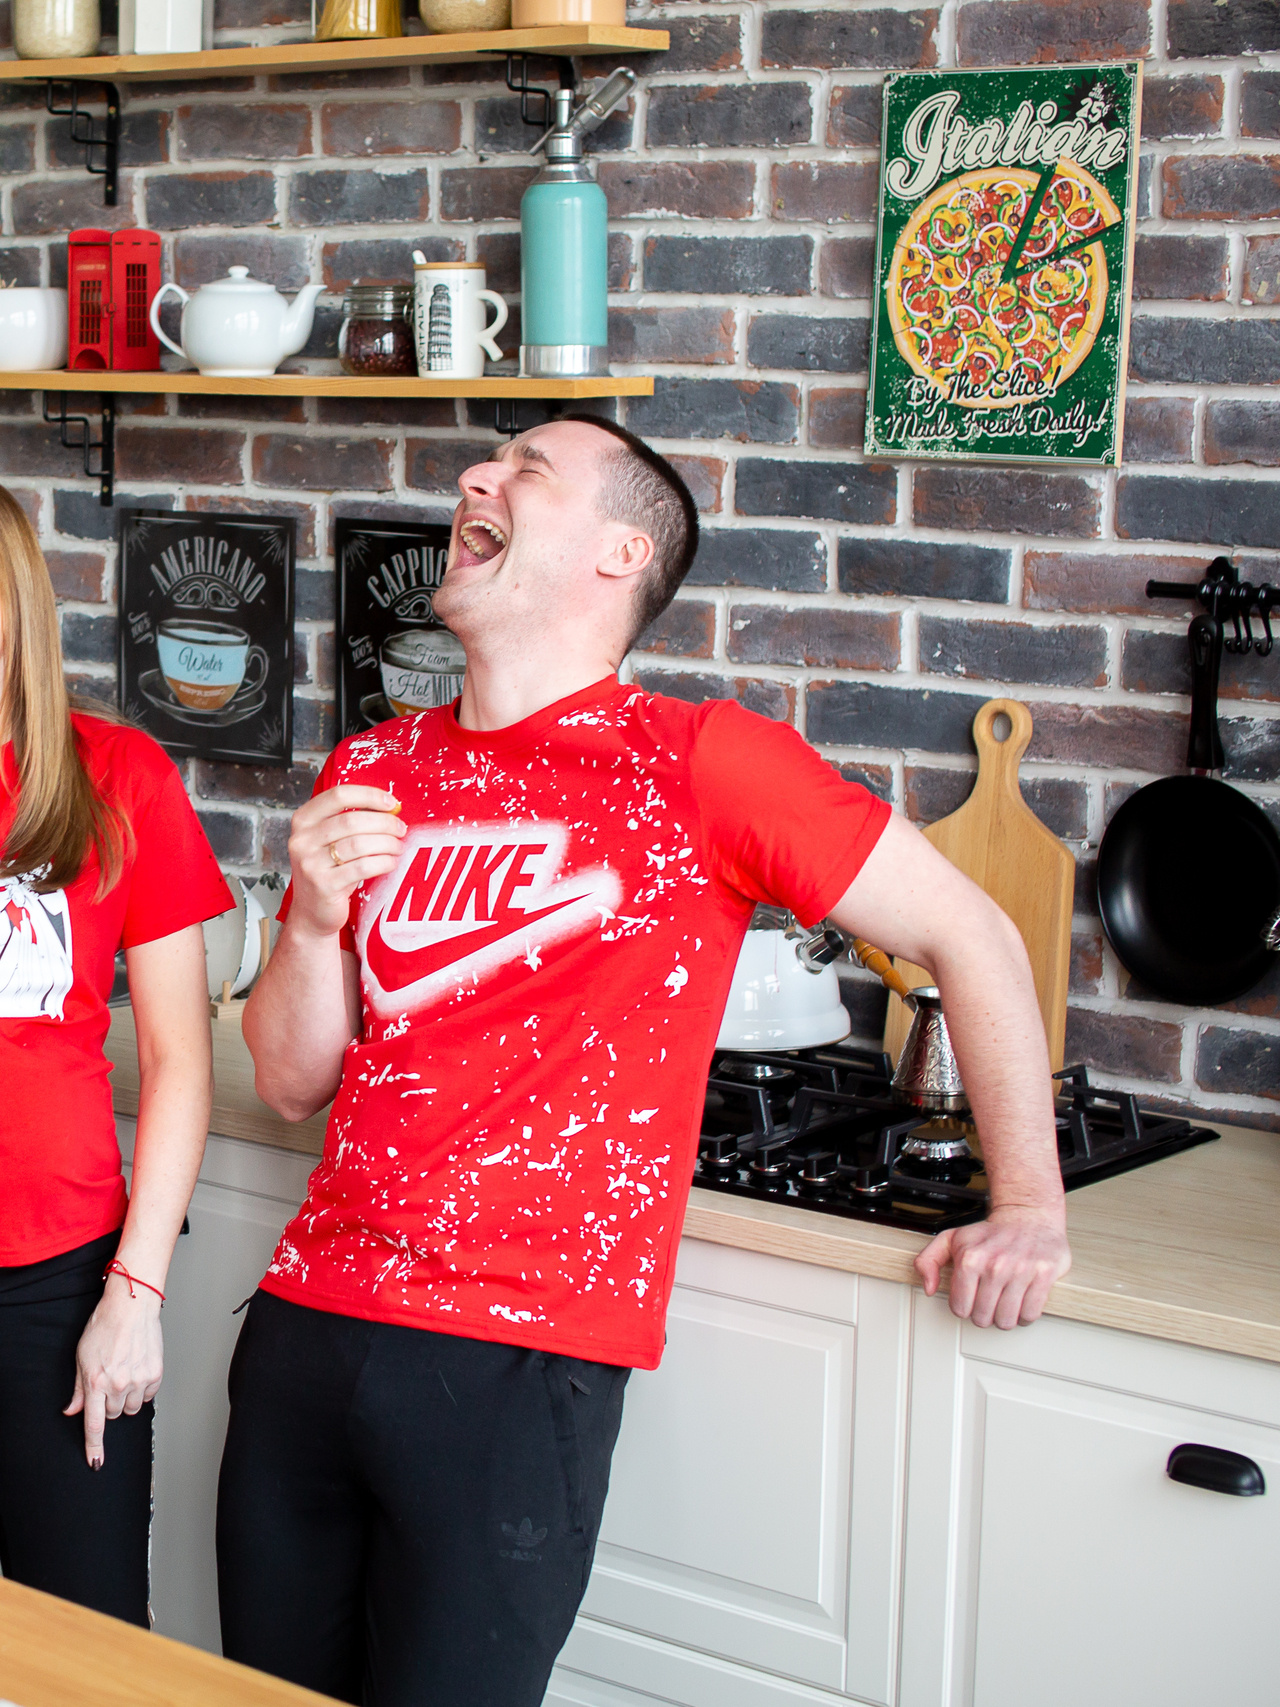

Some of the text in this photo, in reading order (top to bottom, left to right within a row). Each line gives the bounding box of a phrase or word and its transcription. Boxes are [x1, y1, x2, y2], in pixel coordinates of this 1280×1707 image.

[886, 90, 1127, 200] Italian
[418, 302, 426, 345] ITALY
[905, 365, 1064, 418] By The Slice!
[884, 398, 1110, 448] Made Fresh Daily!
[149, 535, 267, 604] AMERICANO
[178, 645, 224, 672] Water
[389, 672, 431, 698] Hot
[385, 843, 549, 923] NIKE
